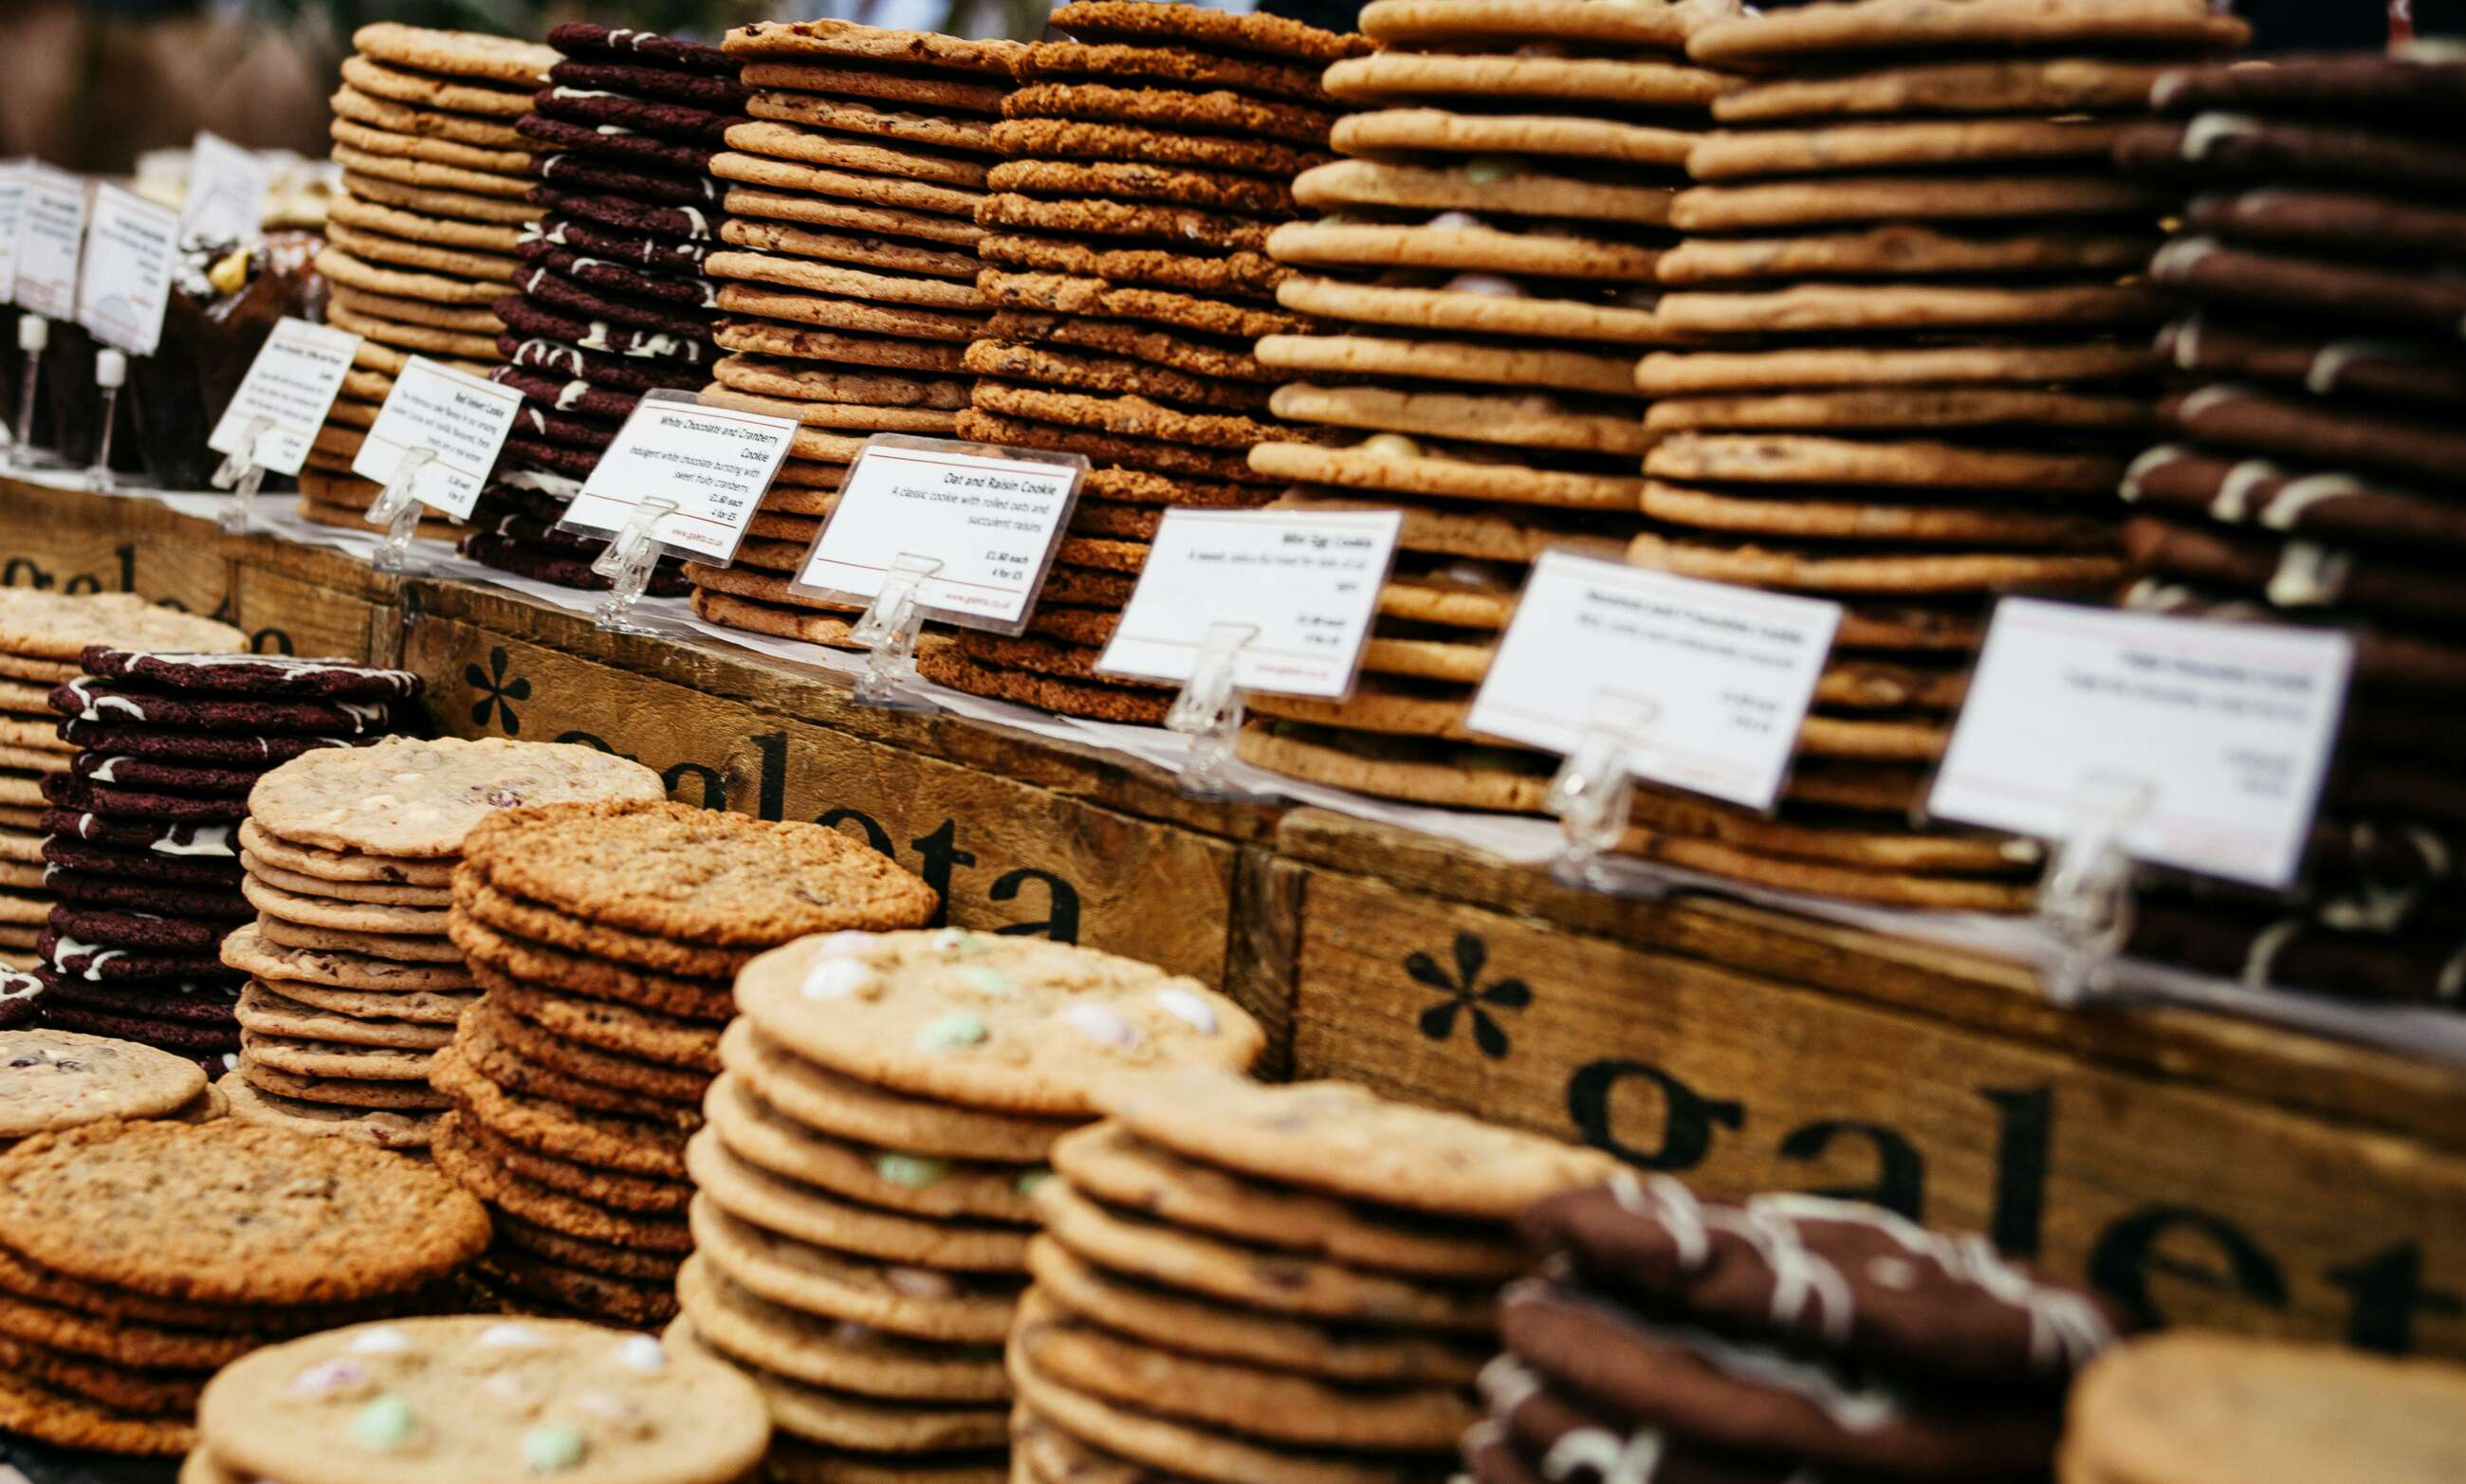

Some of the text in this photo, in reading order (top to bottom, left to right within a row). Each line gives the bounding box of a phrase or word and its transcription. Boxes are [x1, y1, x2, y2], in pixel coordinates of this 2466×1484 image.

[661, 416, 778, 447] White Chocolate and Cranberry
[741, 448, 769, 462] Cookie
[945, 472, 1057, 495] Oat and Raisin Cookie
[900, 487, 928, 499] classic
[929, 492, 959, 504] cookie
[961, 496, 981, 505] with
[984, 497, 1009, 509] rolled
[1010, 502, 1029, 512] oats
[1031, 504, 1050, 514] and
